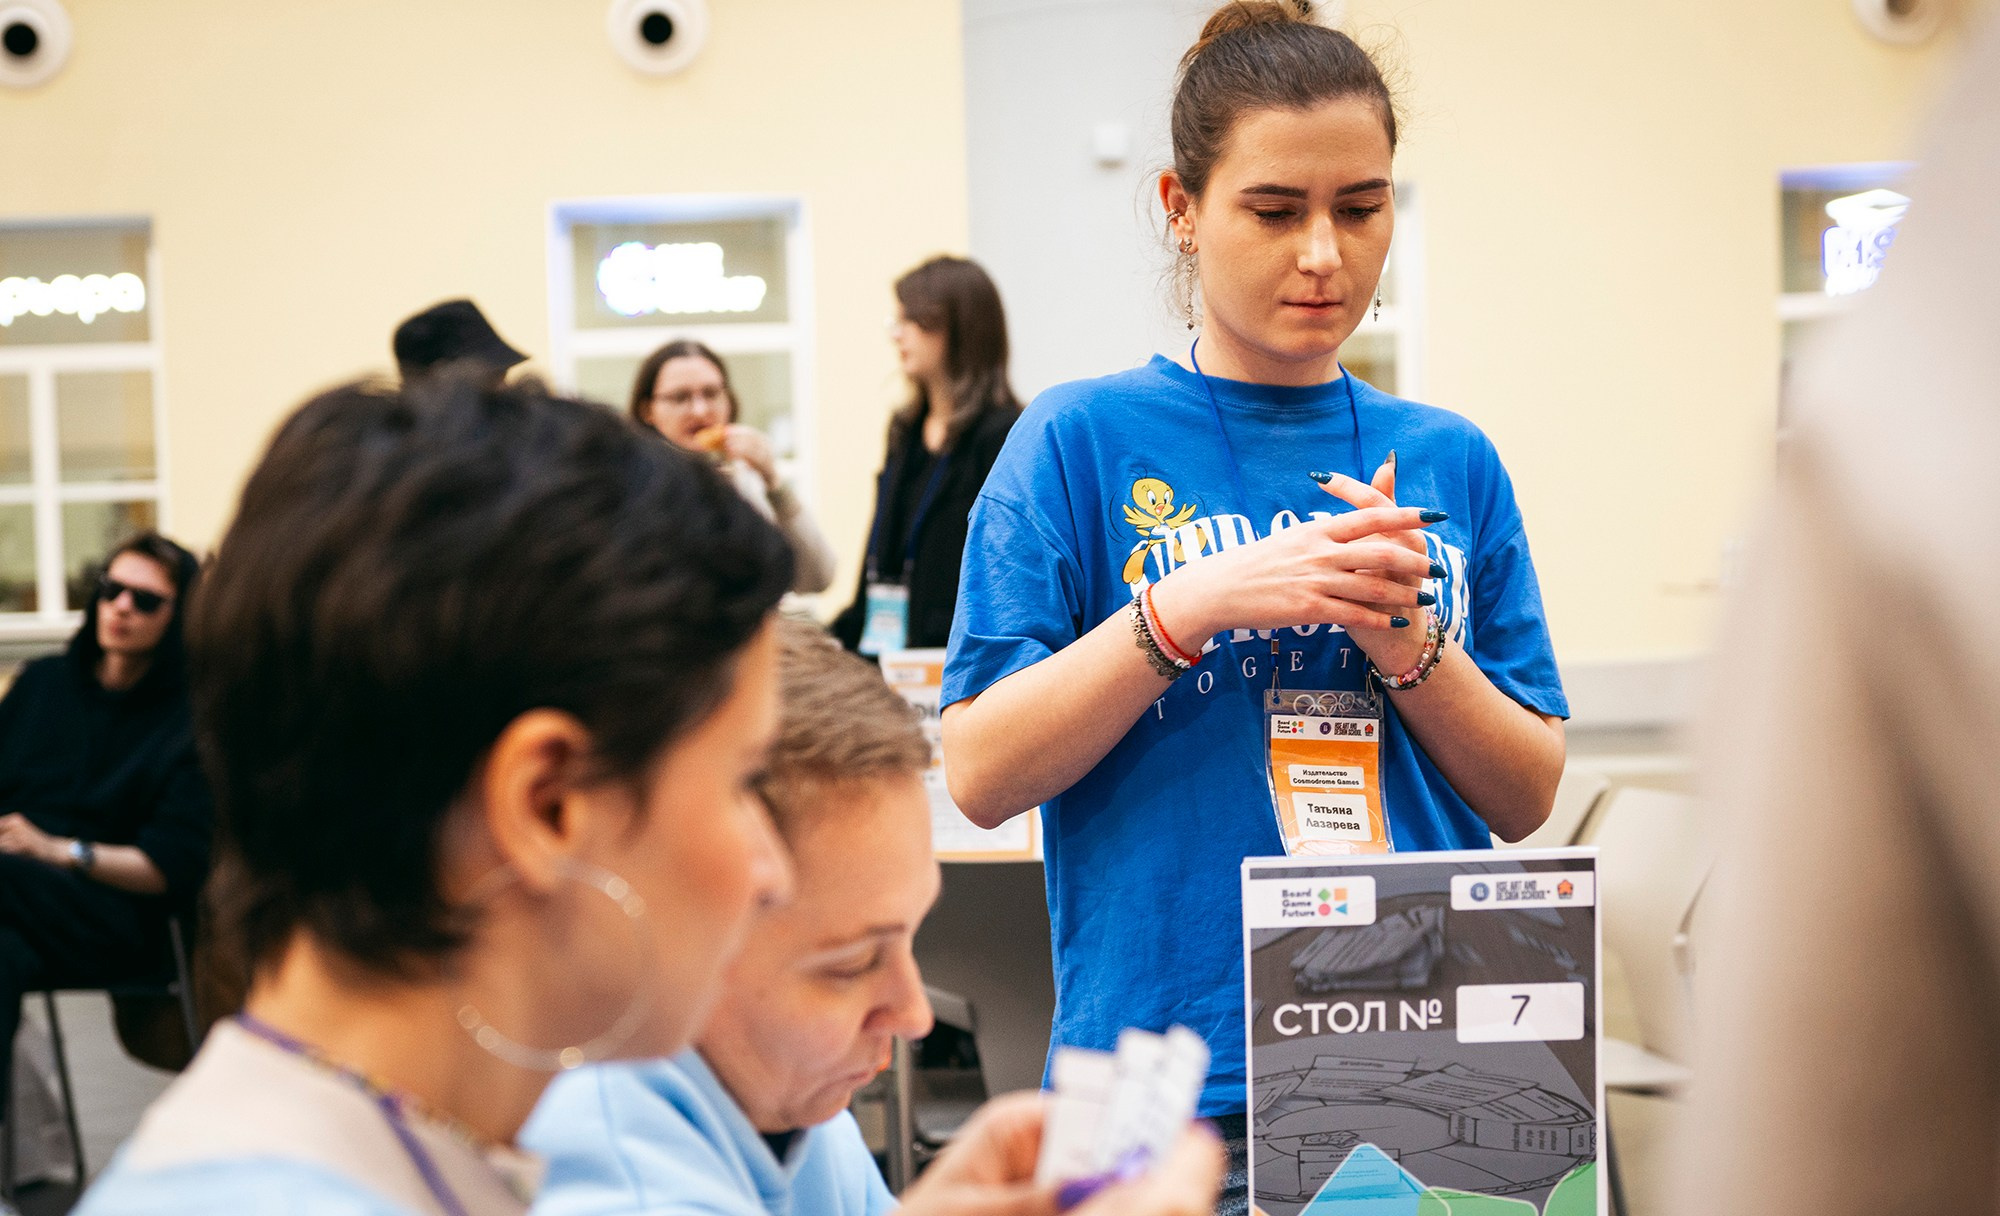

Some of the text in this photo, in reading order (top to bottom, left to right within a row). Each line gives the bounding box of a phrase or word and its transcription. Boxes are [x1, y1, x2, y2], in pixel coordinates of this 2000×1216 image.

[1302, 769, 1348, 777] Издательство
[1292, 777, 1360, 786] Cosmodrome Games
[1307, 803, 1353, 815] Татьяна
[1305, 817, 1361, 831] Лазарева
[1282, 888, 1312, 898] Board
[1282, 899, 1312, 908] Game
[1282, 909, 1315, 918] Future
[1272, 994, 1531, 1036] СТОЛ № 7
